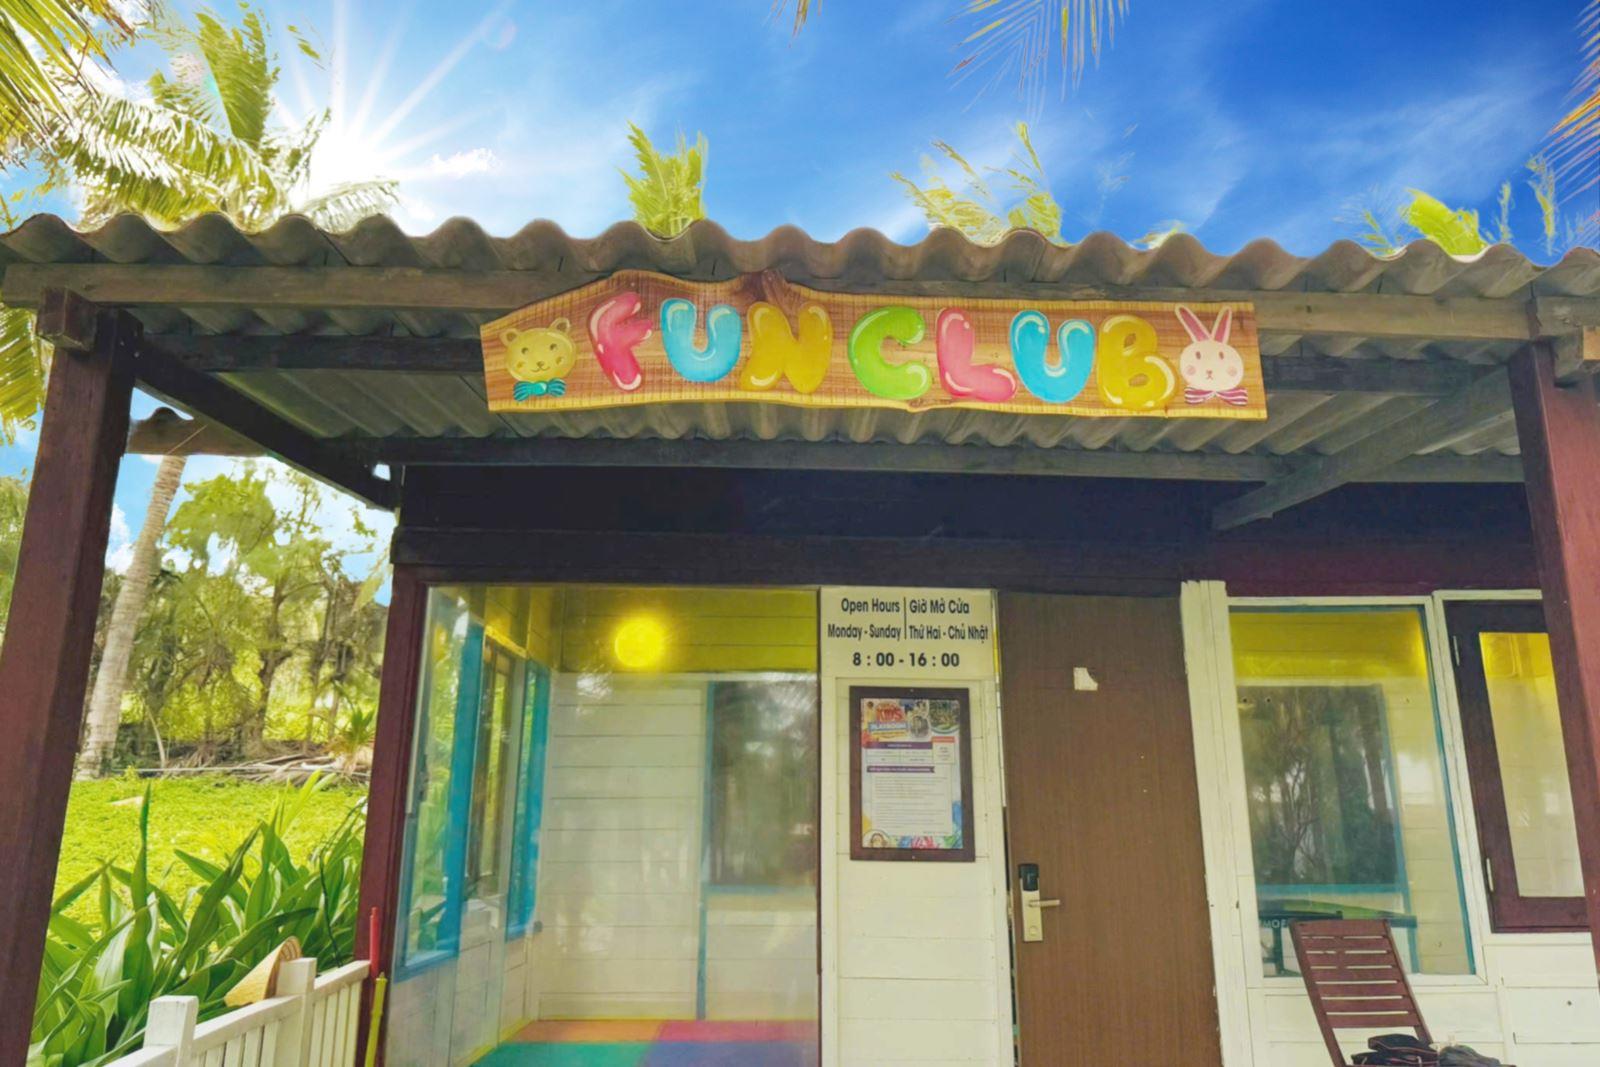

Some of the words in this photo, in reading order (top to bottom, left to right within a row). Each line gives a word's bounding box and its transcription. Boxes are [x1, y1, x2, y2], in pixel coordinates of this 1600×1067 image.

[586, 293, 833, 392] FUN
[846, 305, 1175, 410] CLUB
[841, 598, 868, 614] Open
[872, 598, 900, 612] Hours
[828, 624, 862, 641] Monday
[870, 624, 900, 641] Sunday
[927, 626, 941, 639] Hai
